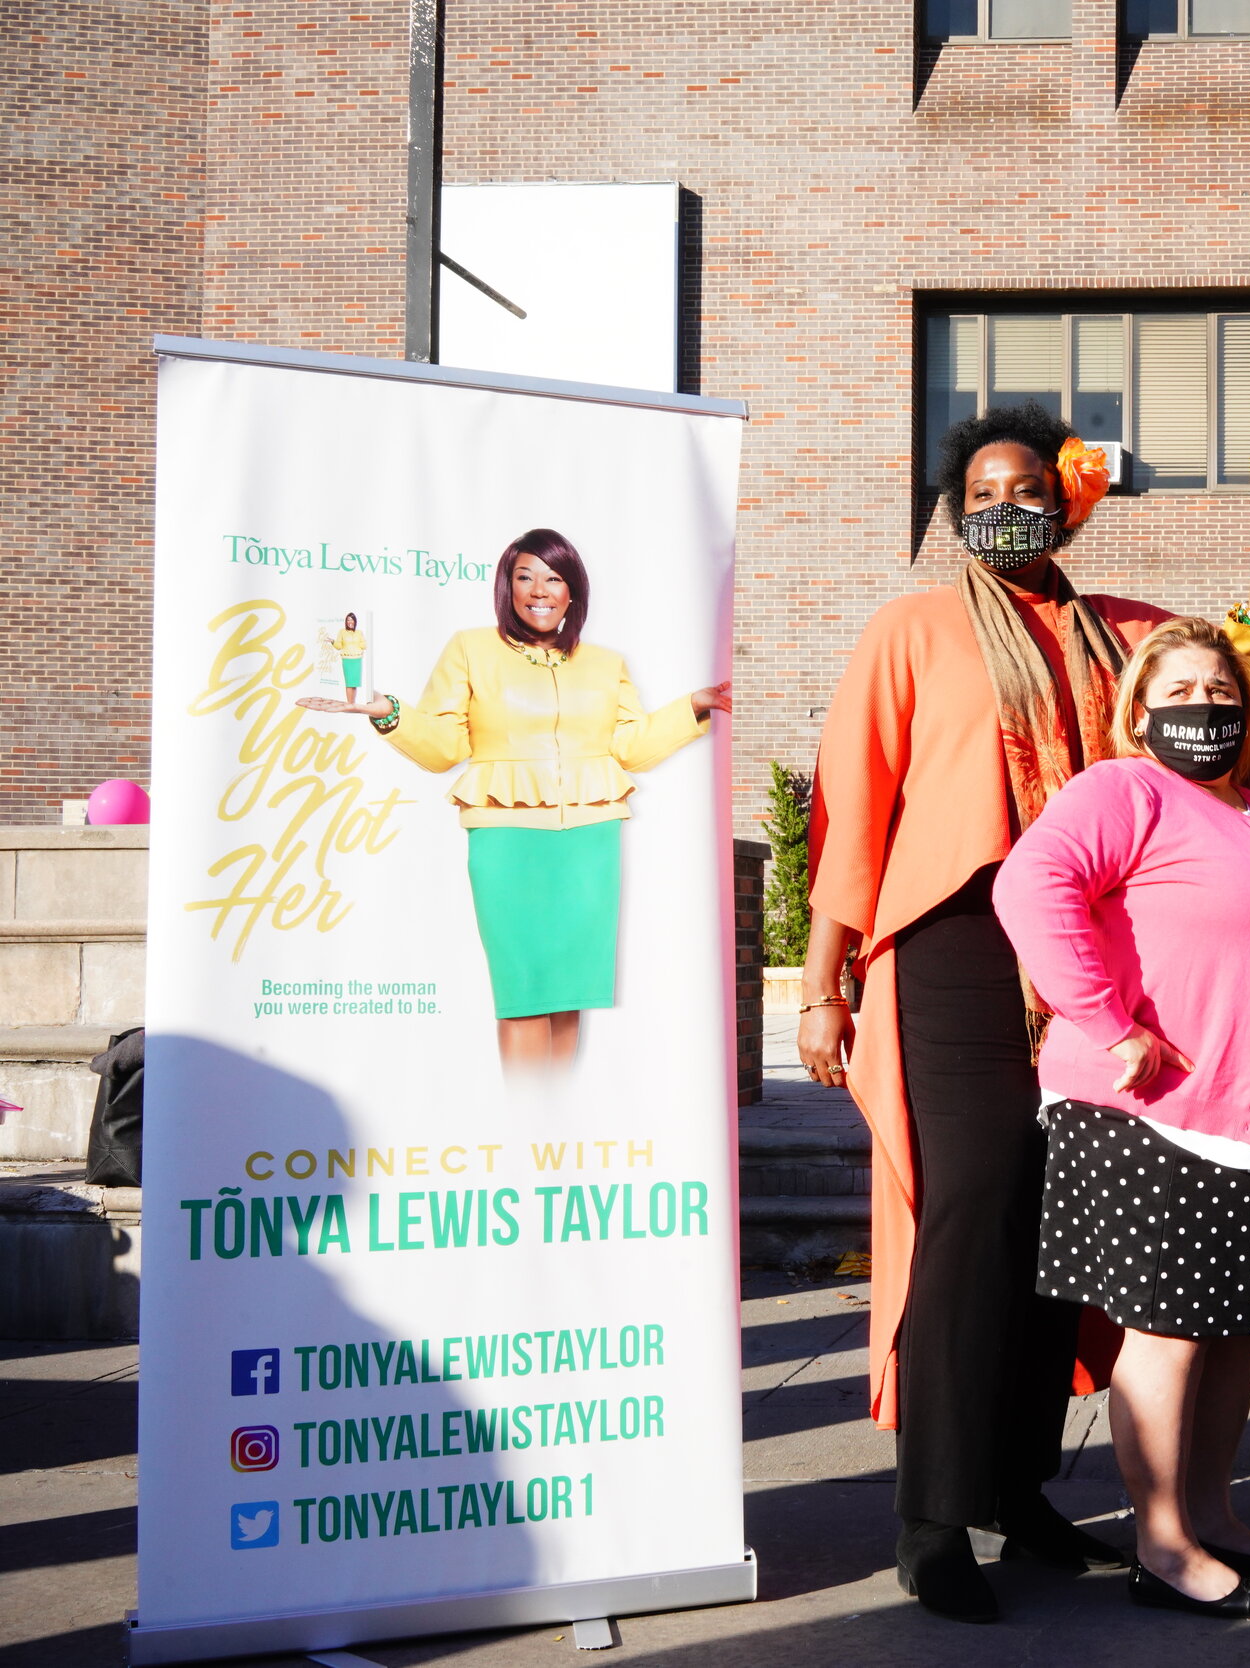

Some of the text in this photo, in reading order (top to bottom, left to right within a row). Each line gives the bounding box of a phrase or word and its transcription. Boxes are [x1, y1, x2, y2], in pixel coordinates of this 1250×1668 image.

[222, 534, 492, 587] Tõnya Lewis Taylor
[968, 525, 1044, 550] QUEEN
[187, 598, 314, 716] Be
[218, 688, 368, 822] You
[1163, 720, 1241, 741] DARMA V. DIAZ
[1174, 741, 1191, 750] CITY
[268, 776, 418, 880] Not
[184, 841, 354, 965] Her
[254, 998, 442, 1018] you were created to be.
[261, 978, 437, 998] Becoming the woman
[245, 1139, 654, 1182] CONNECT WITH
[181, 1180, 708, 1260] TÕNYA LEWIS TAYLOR
[294, 1323, 664, 1392] TONYALEWISTAYLOR
[294, 1394, 664, 1468] TONYALEWISTAYLOR
[294, 1472, 594, 1545] TONYALTAYLOR1
